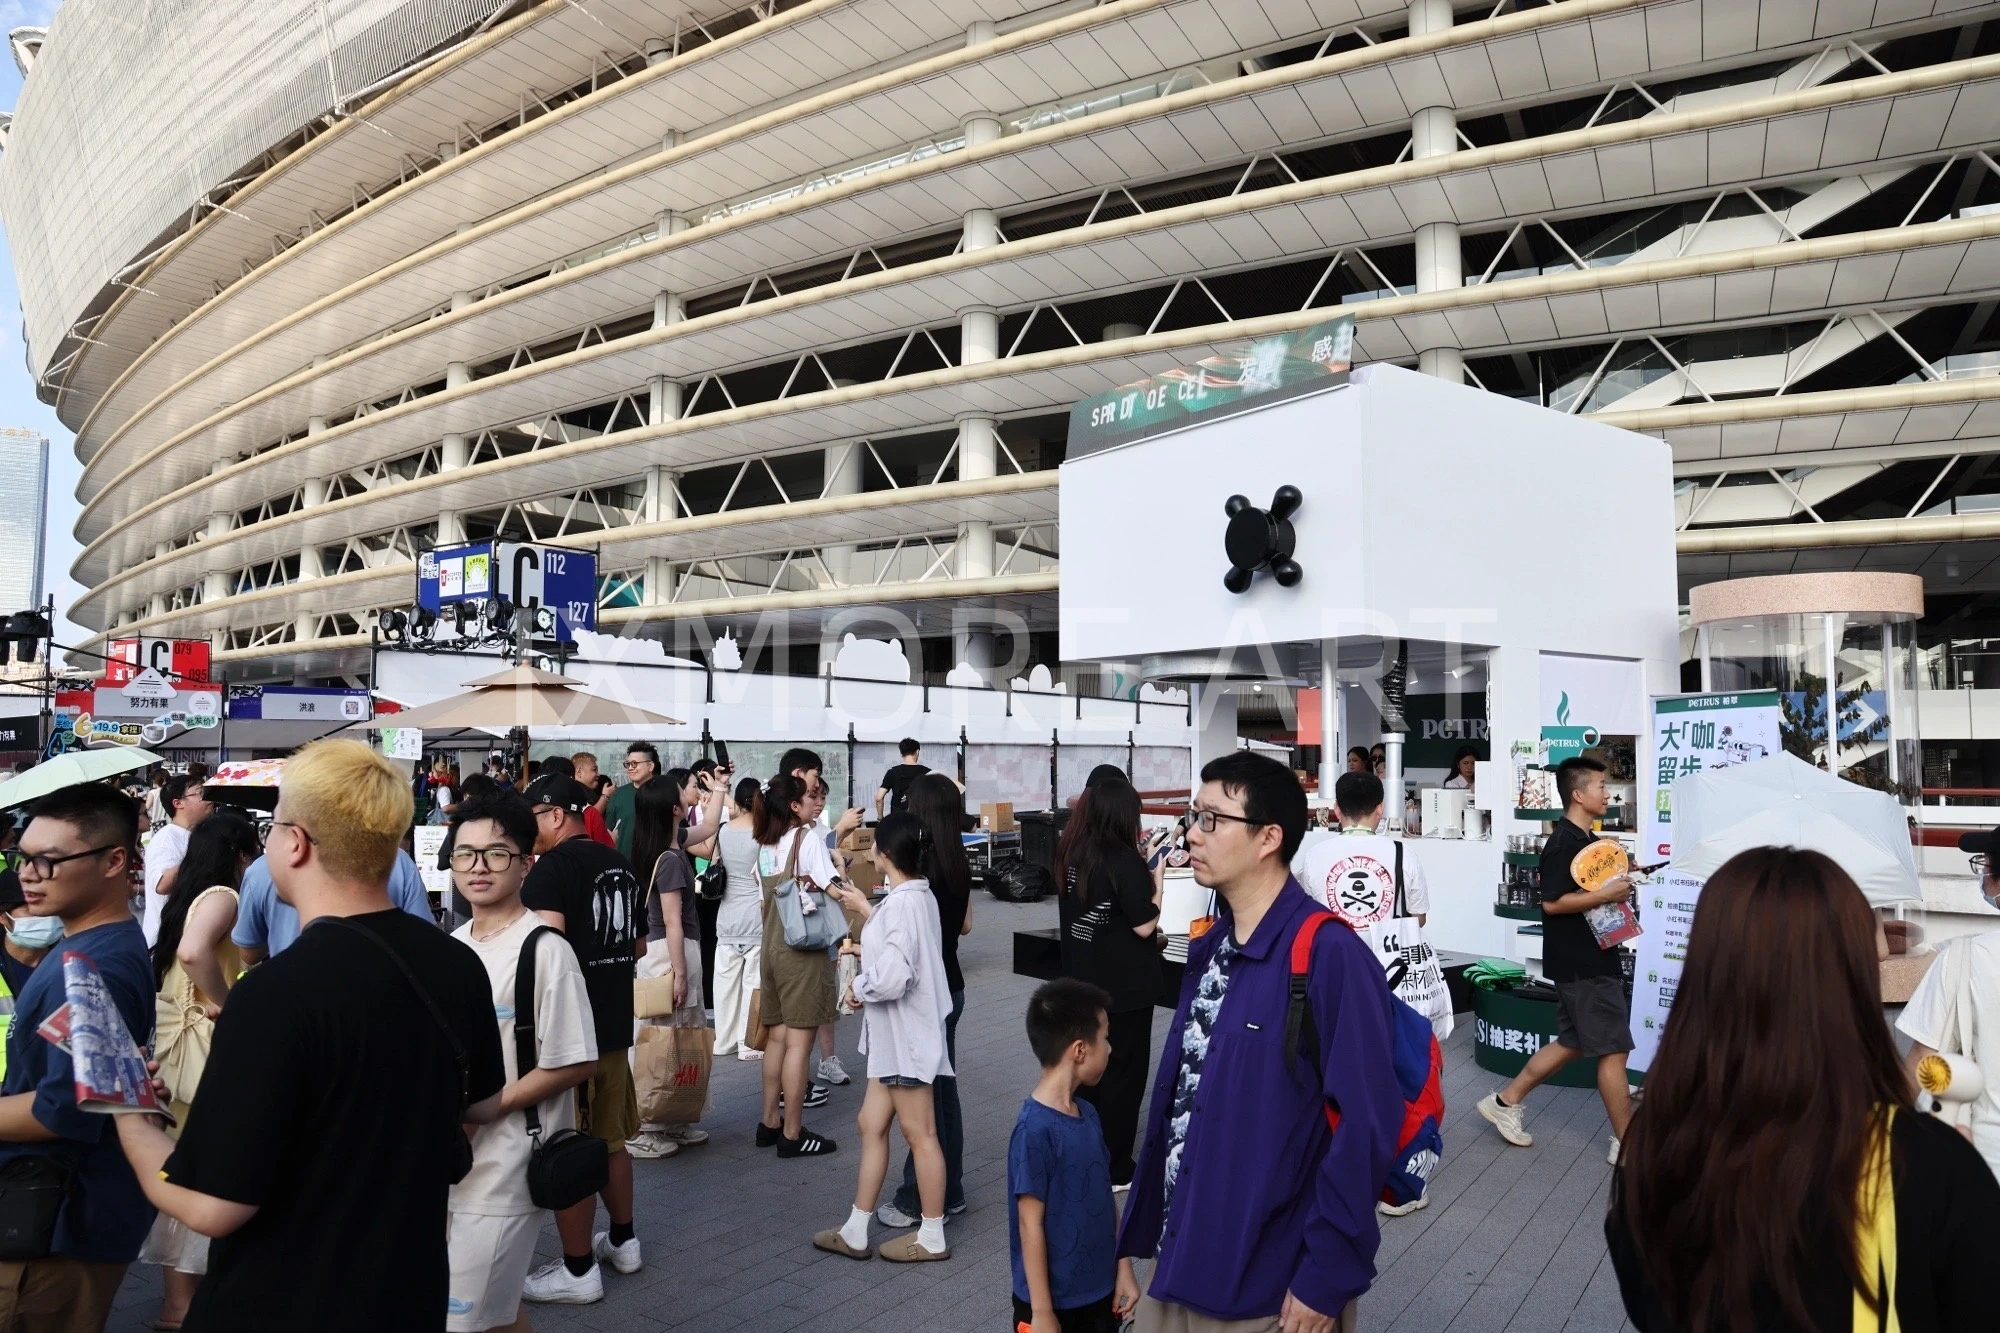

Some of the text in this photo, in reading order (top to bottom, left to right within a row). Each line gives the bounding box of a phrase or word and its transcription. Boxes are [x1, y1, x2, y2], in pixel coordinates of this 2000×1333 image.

[546, 553, 565, 575] 112
[513, 547, 538, 609] C
[568, 601, 589, 622] 127
[174, 643, 192, 655] 079
[151, 641, 169, 678] C
[188, 669, 207, 681] 095
[131, 697, 168, 708] 努力有果
[299, 702, 315, 712] 洪浪
[1688, 697, 1720, 708] PETRUS
[1548, 739, 1580, 748] PETRUS
[1657, 876, 1665, 884] 01
[1654, 901, 1663, 909] 02
[1648, 974, 1657, 983] 03
[1489, 1024, 1558, 1055] 抽奖礼
